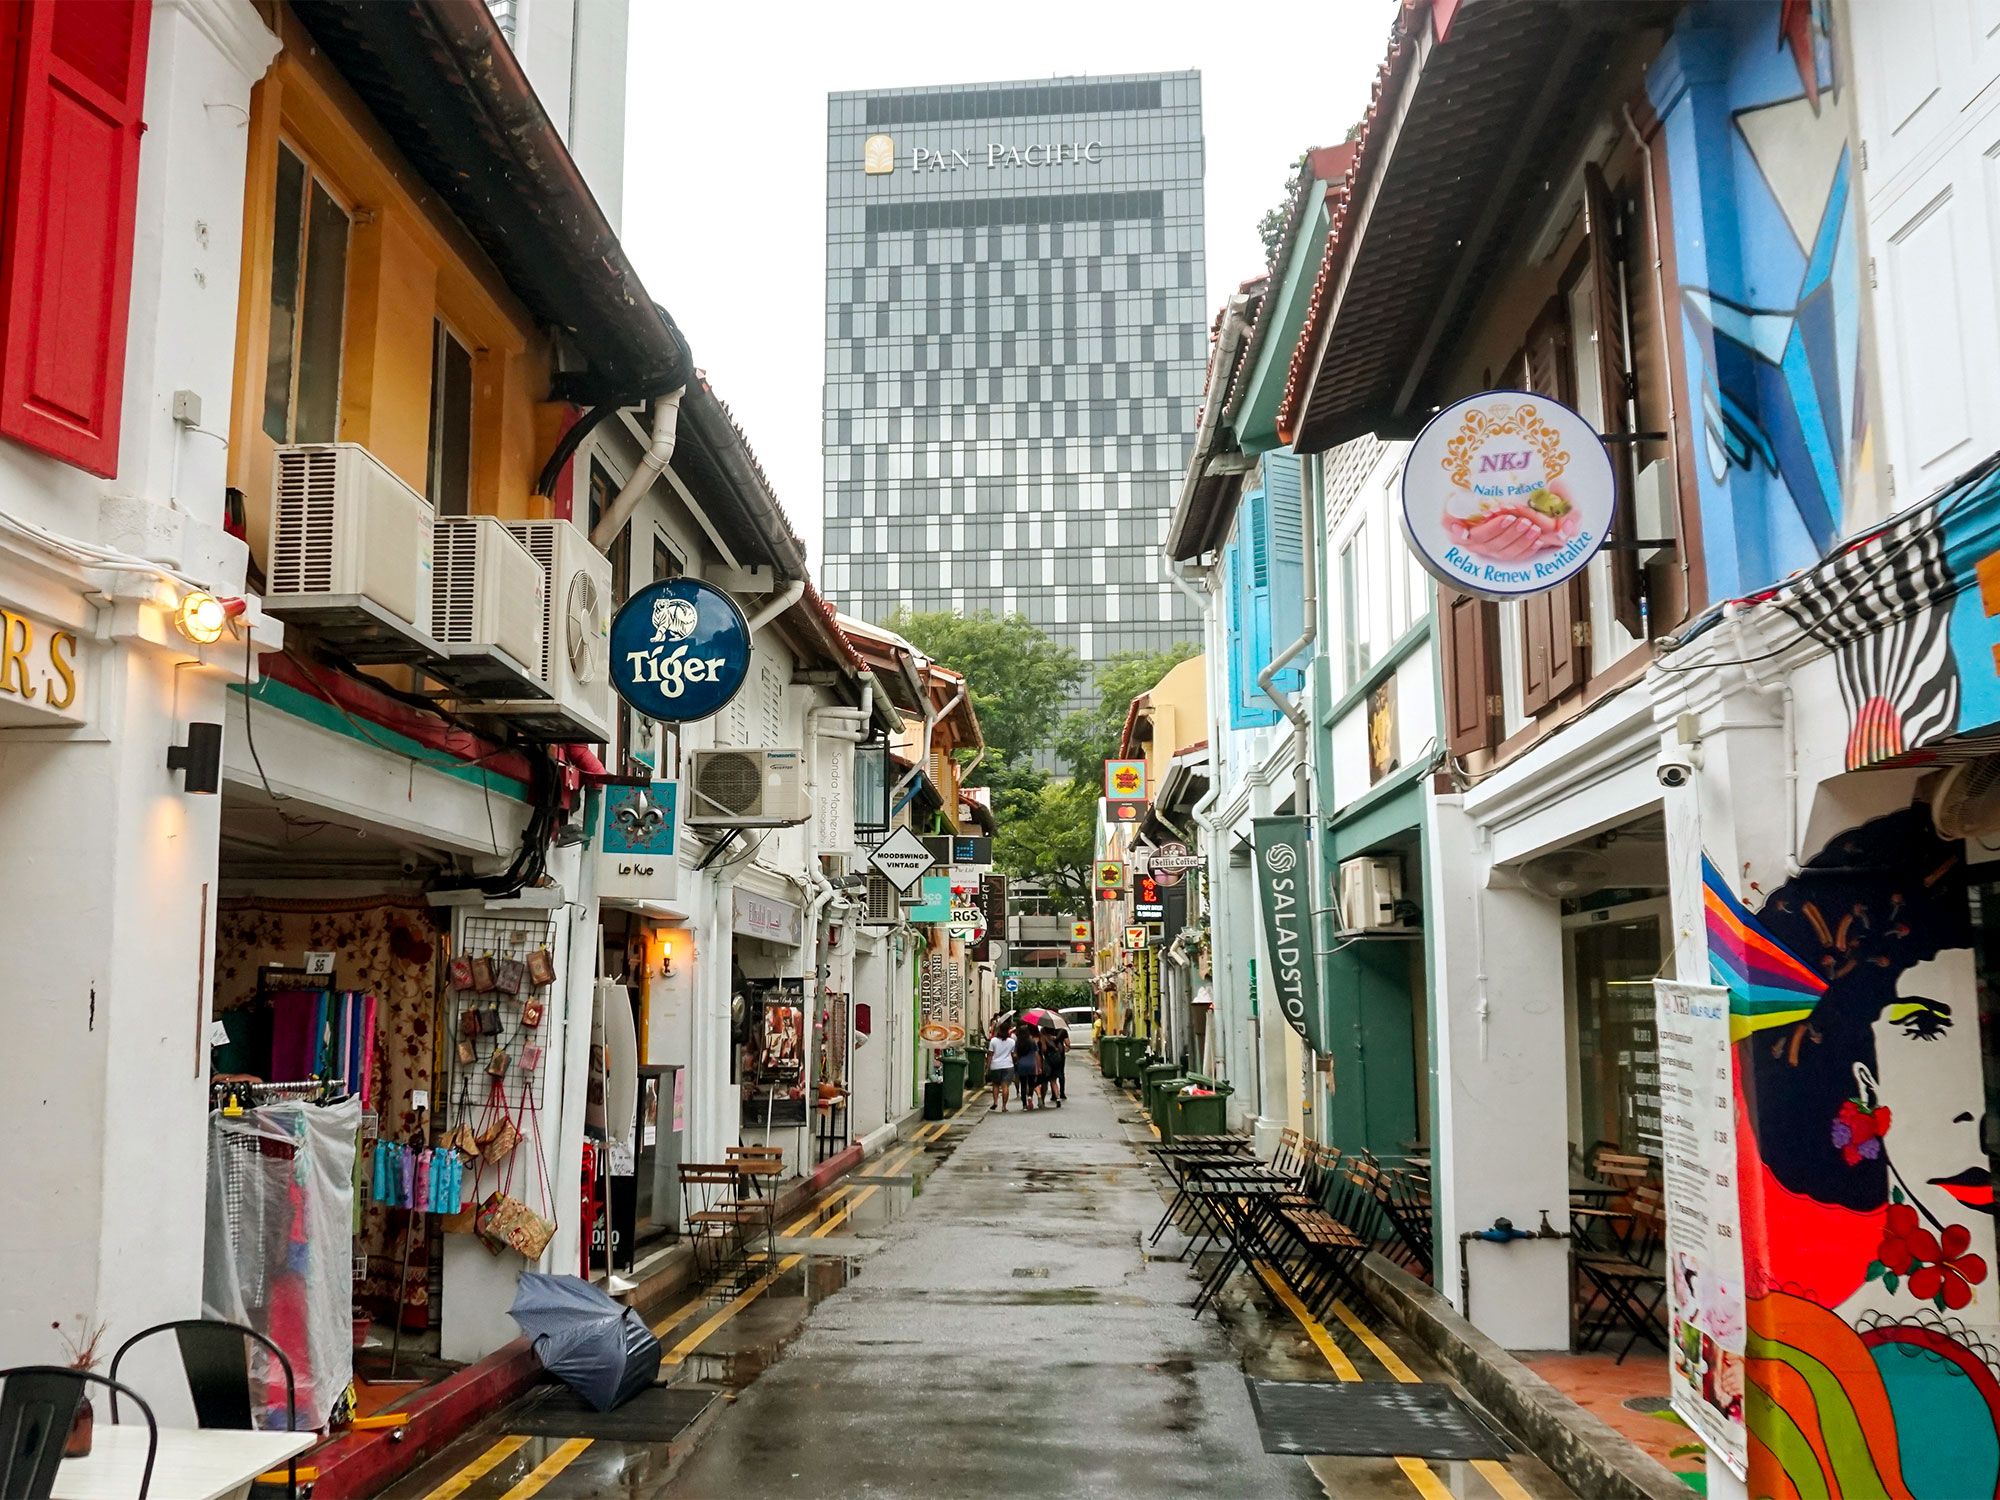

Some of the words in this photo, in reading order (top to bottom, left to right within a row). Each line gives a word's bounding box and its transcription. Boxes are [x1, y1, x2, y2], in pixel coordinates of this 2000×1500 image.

[911, 146, 971, 173] PAN
[986, 140, 1103, 169] PACIFIC
[1479, 450, 1534, 474] NKJ
[1473, 483, 1505, 497] Nails
[1507, 479, 1546, 497] Palace
[1443, 546, 1481, 577] Relax
[1483, 564, 1532, 583] Renew
[1533, 529, 1594, 579] Revitalize
[626, 644, 726, 699] Tiger
[831, 751, 842, 789] Sandra
[829, 791, 841, 849] Macheroux
[618, 862, 632, 876] Le
[633, 862, 655, 876] Kue
[877, 852, 929, 860] MOODSWINGS
[1175, 856, 1197, 866] Coffee
[951, 910, 979, 922] RGS
[922, 960, 930, 969] &
[921, 972, 931, 1016] COFFEE
[931, 953, 943, 1022] BREAKFAST
[949, 962, 959, 1023] BREAKFAST
